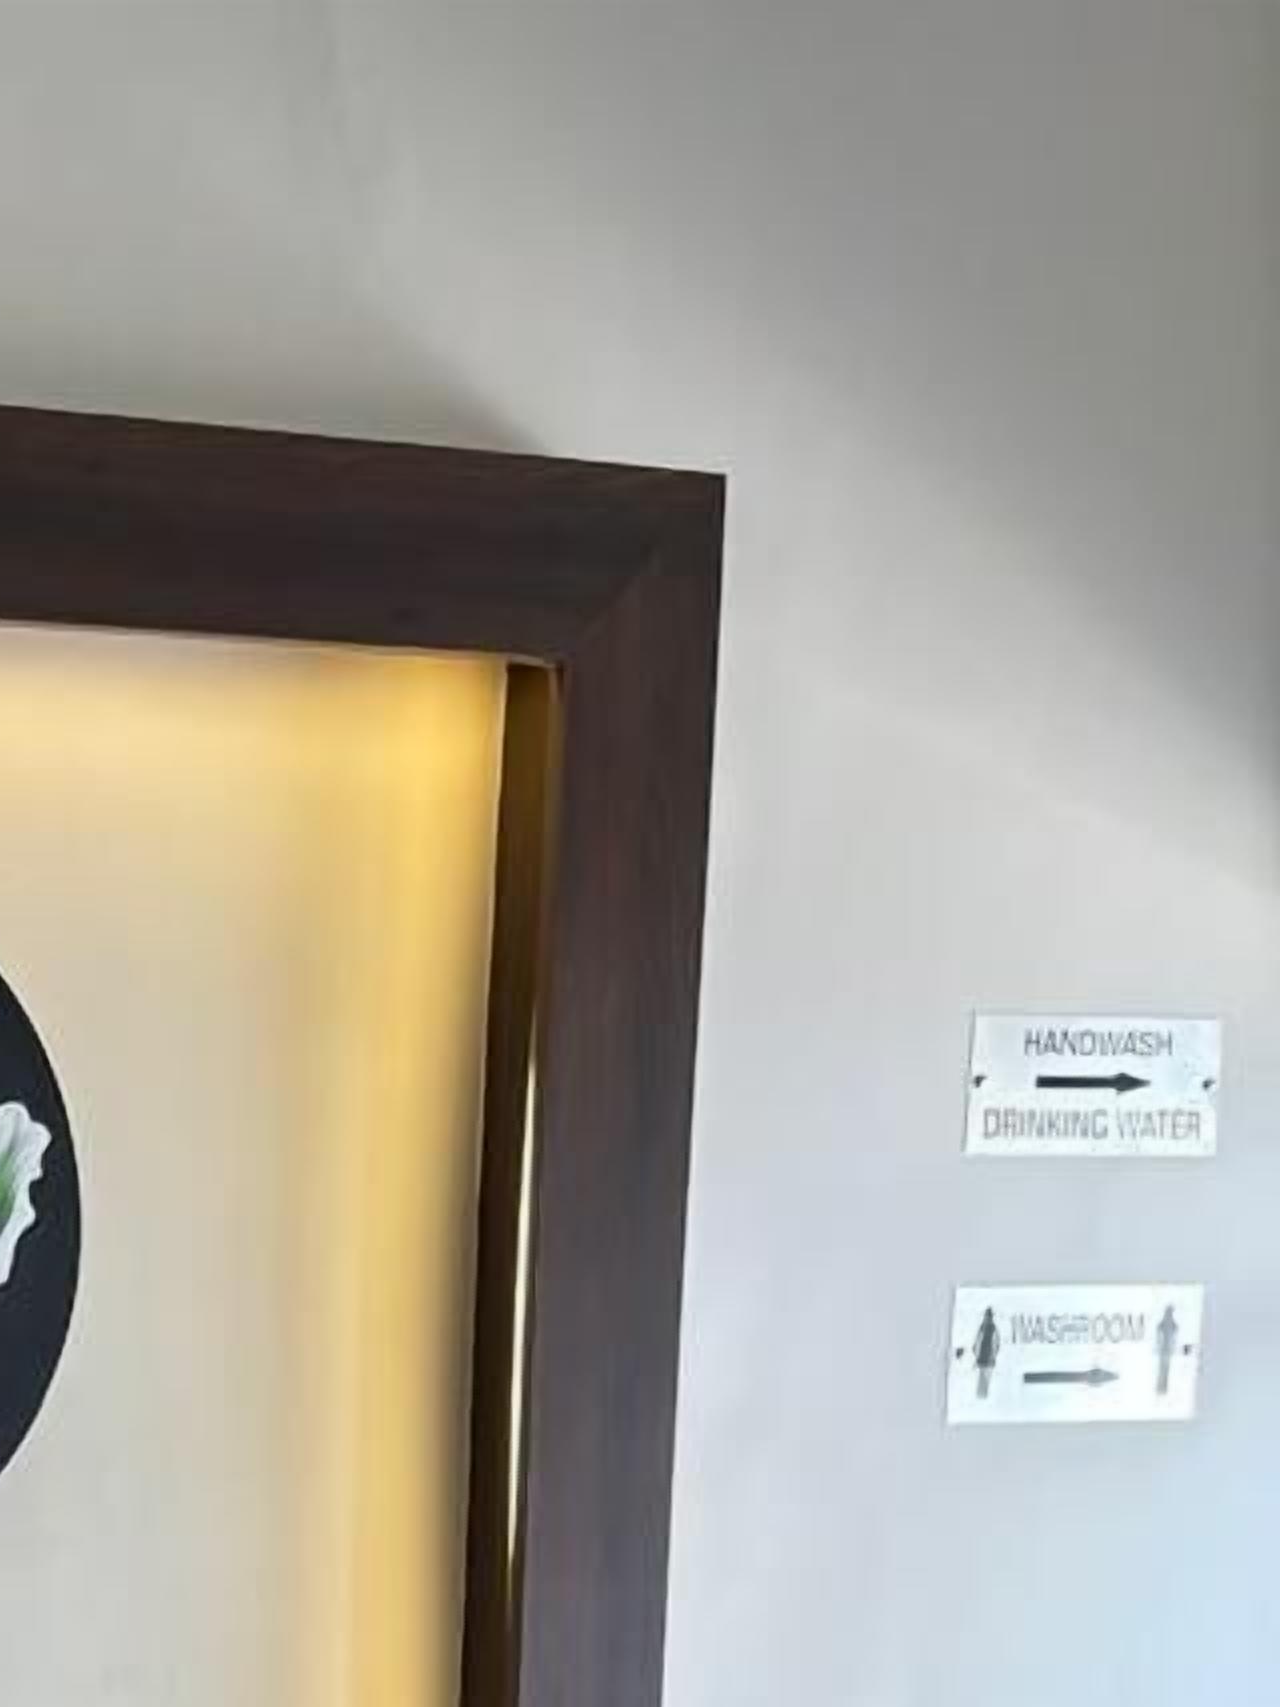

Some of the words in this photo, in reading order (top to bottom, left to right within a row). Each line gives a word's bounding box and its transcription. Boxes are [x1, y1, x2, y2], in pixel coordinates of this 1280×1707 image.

[1024, 1028, 1173, 1057] HANDWASH
[983, 1107, 1109, 1140] DRINKING
[1115, 1107, 1201, 1140] WATER
[1010, 1312, 1145, 1344] WASHROOM
